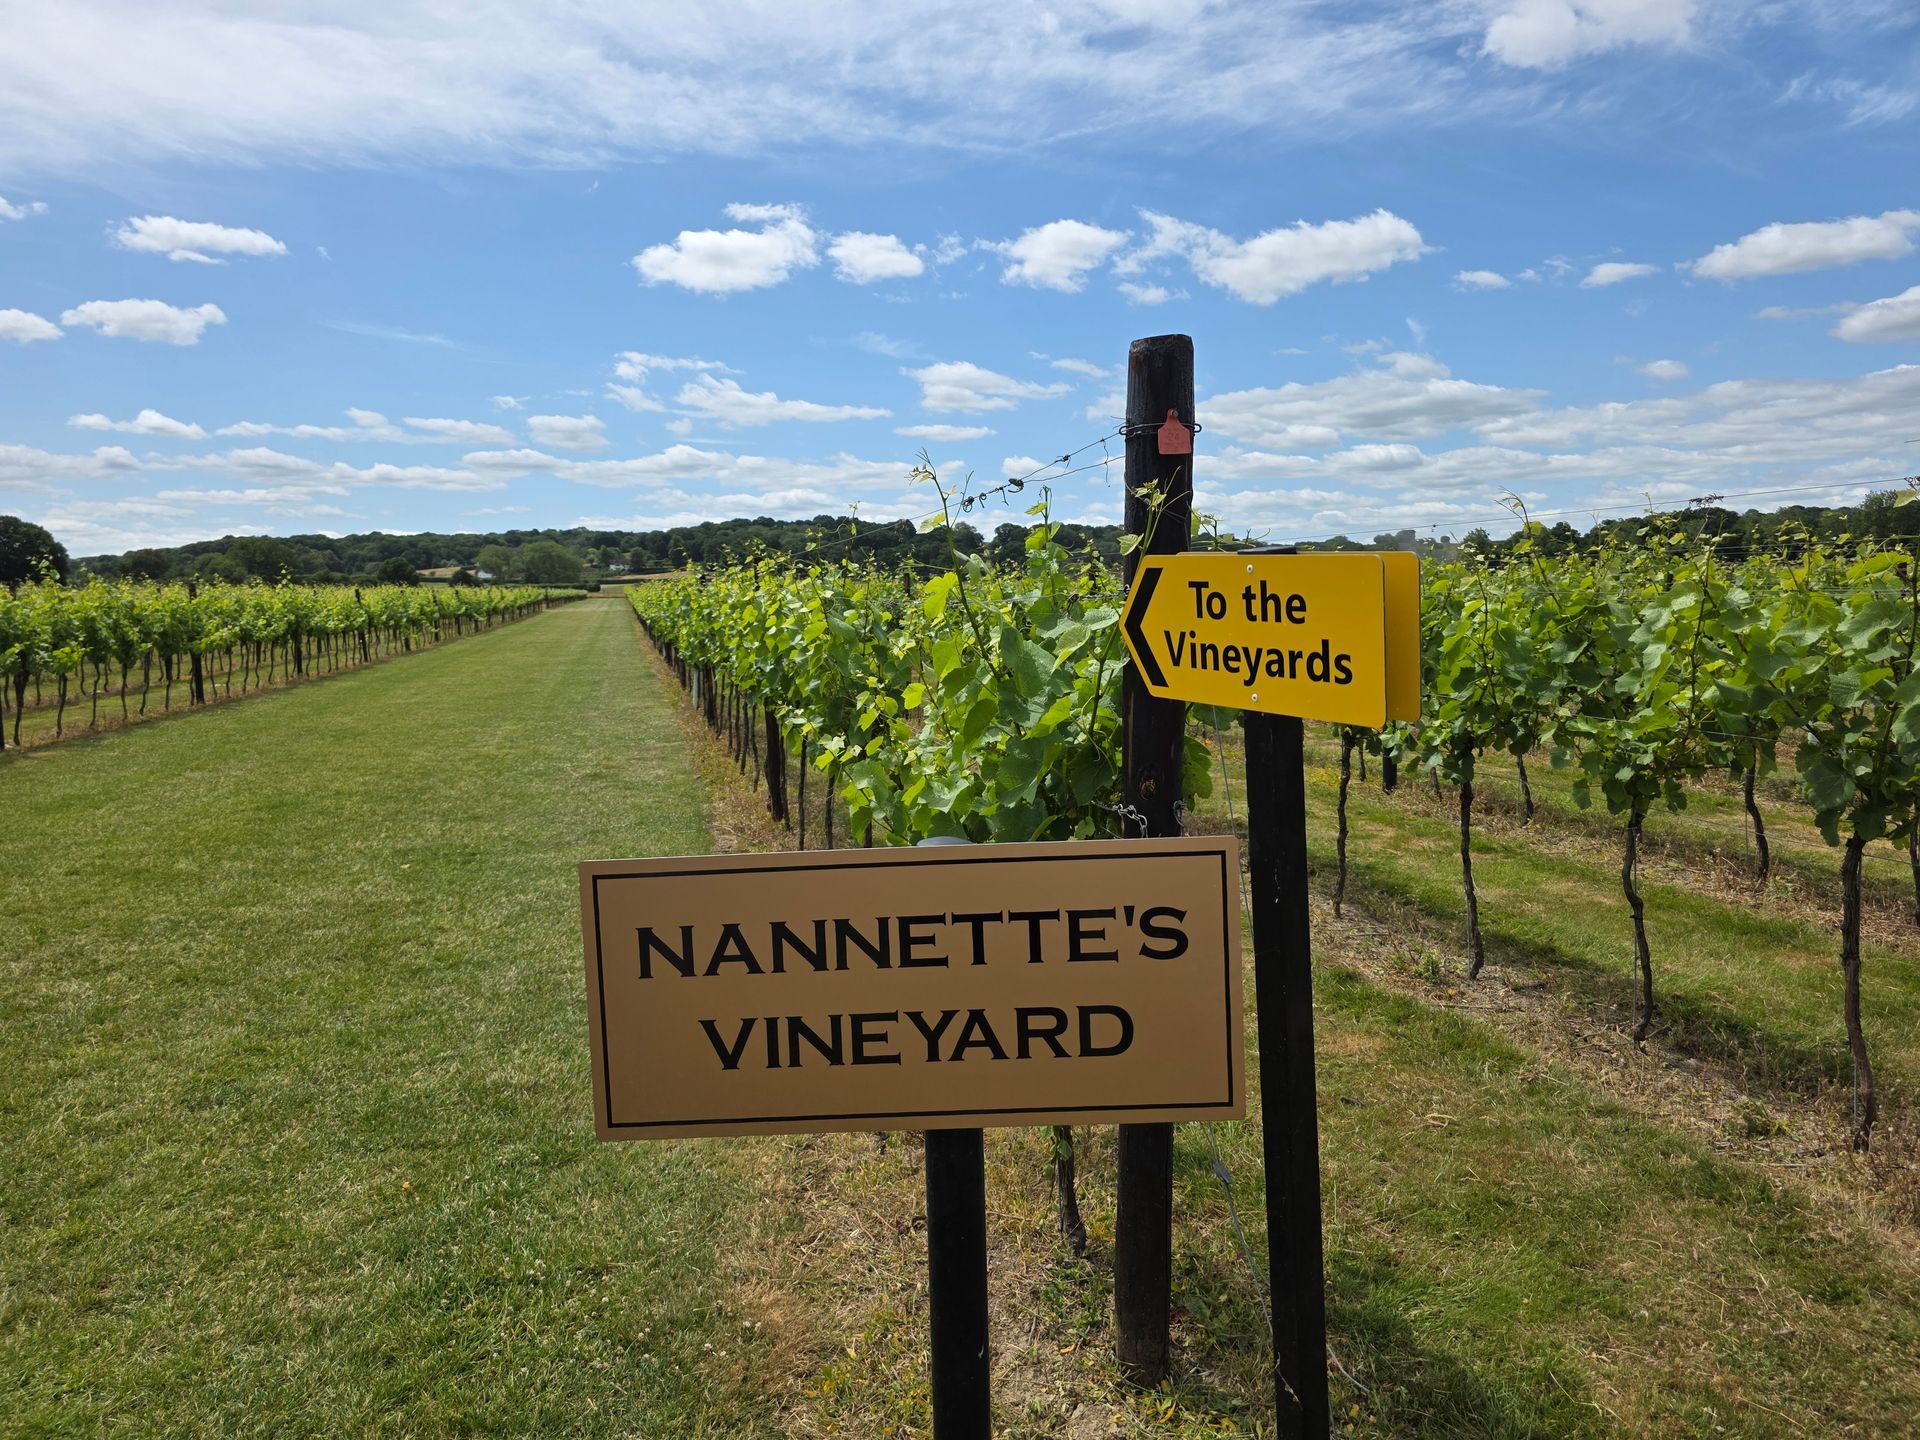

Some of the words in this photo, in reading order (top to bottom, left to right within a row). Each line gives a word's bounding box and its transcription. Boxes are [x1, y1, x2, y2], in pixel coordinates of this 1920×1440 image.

[1188, 581, 1227, 621] To
[1242, 580, 1307, 625] the
[1164, 630, 1354, 688] Vineyards
[635, 905, 1189, 980] NANNETTE'S
[698, 1005, 1135, 1072] VINEYARD
